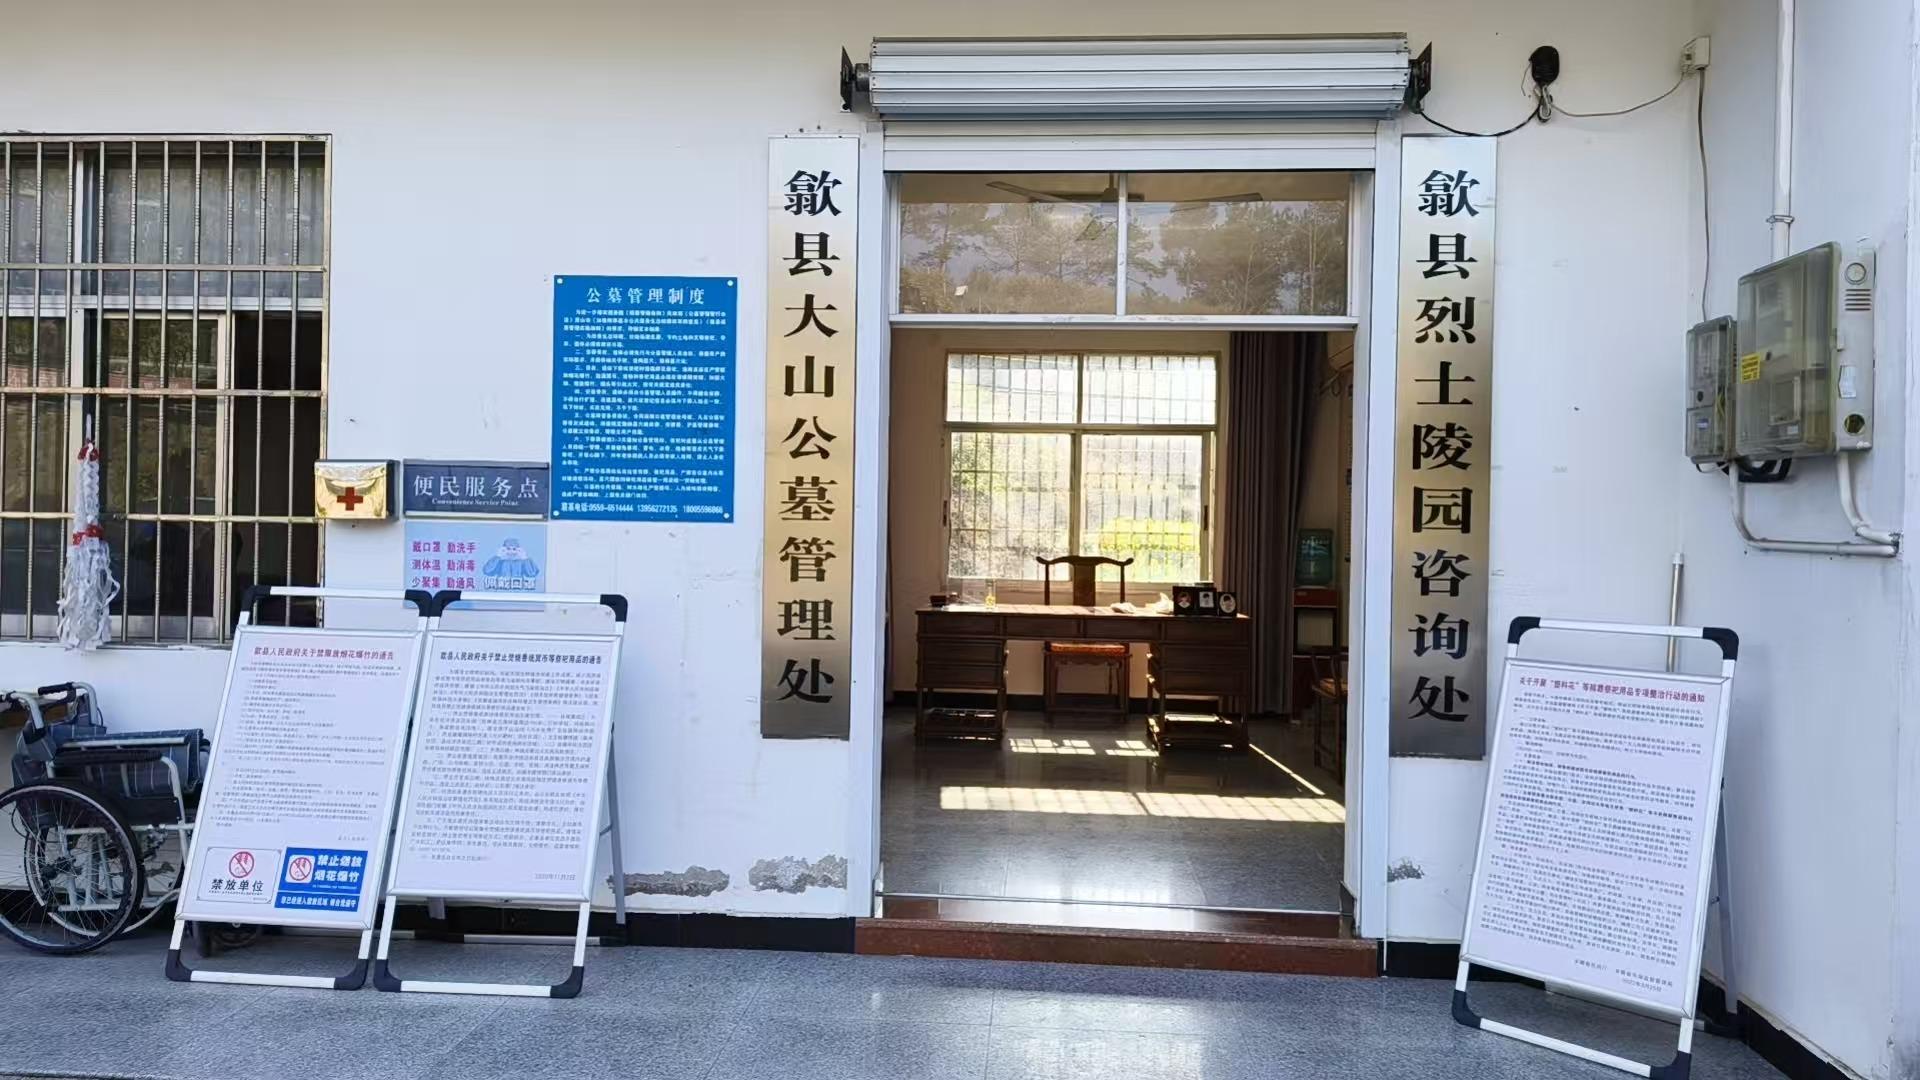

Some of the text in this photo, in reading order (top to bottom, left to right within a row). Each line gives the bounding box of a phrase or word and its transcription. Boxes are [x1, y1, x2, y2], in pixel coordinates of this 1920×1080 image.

[586, 287, 705, 305] 公墓管理制度
[778, 170, 842, 704] 歙县大山公墓管理处
[1409, 170, 1480, 722] 歙县烈士陵园咨询处
[413, 475, 539, 498] 便民服务点
[412, 541, 477, 553] 戴口罩 勤洗手
[412, 559, 476, 572] 测体温 勤消毒
[411, 576, 476, 588] 少聚集 勤通风
[317, 854, 363, 868] 禁止燃放
[314, 869, 360, 883] 烟花爆竹
[211, 878, 264, 892] 禁放单位
